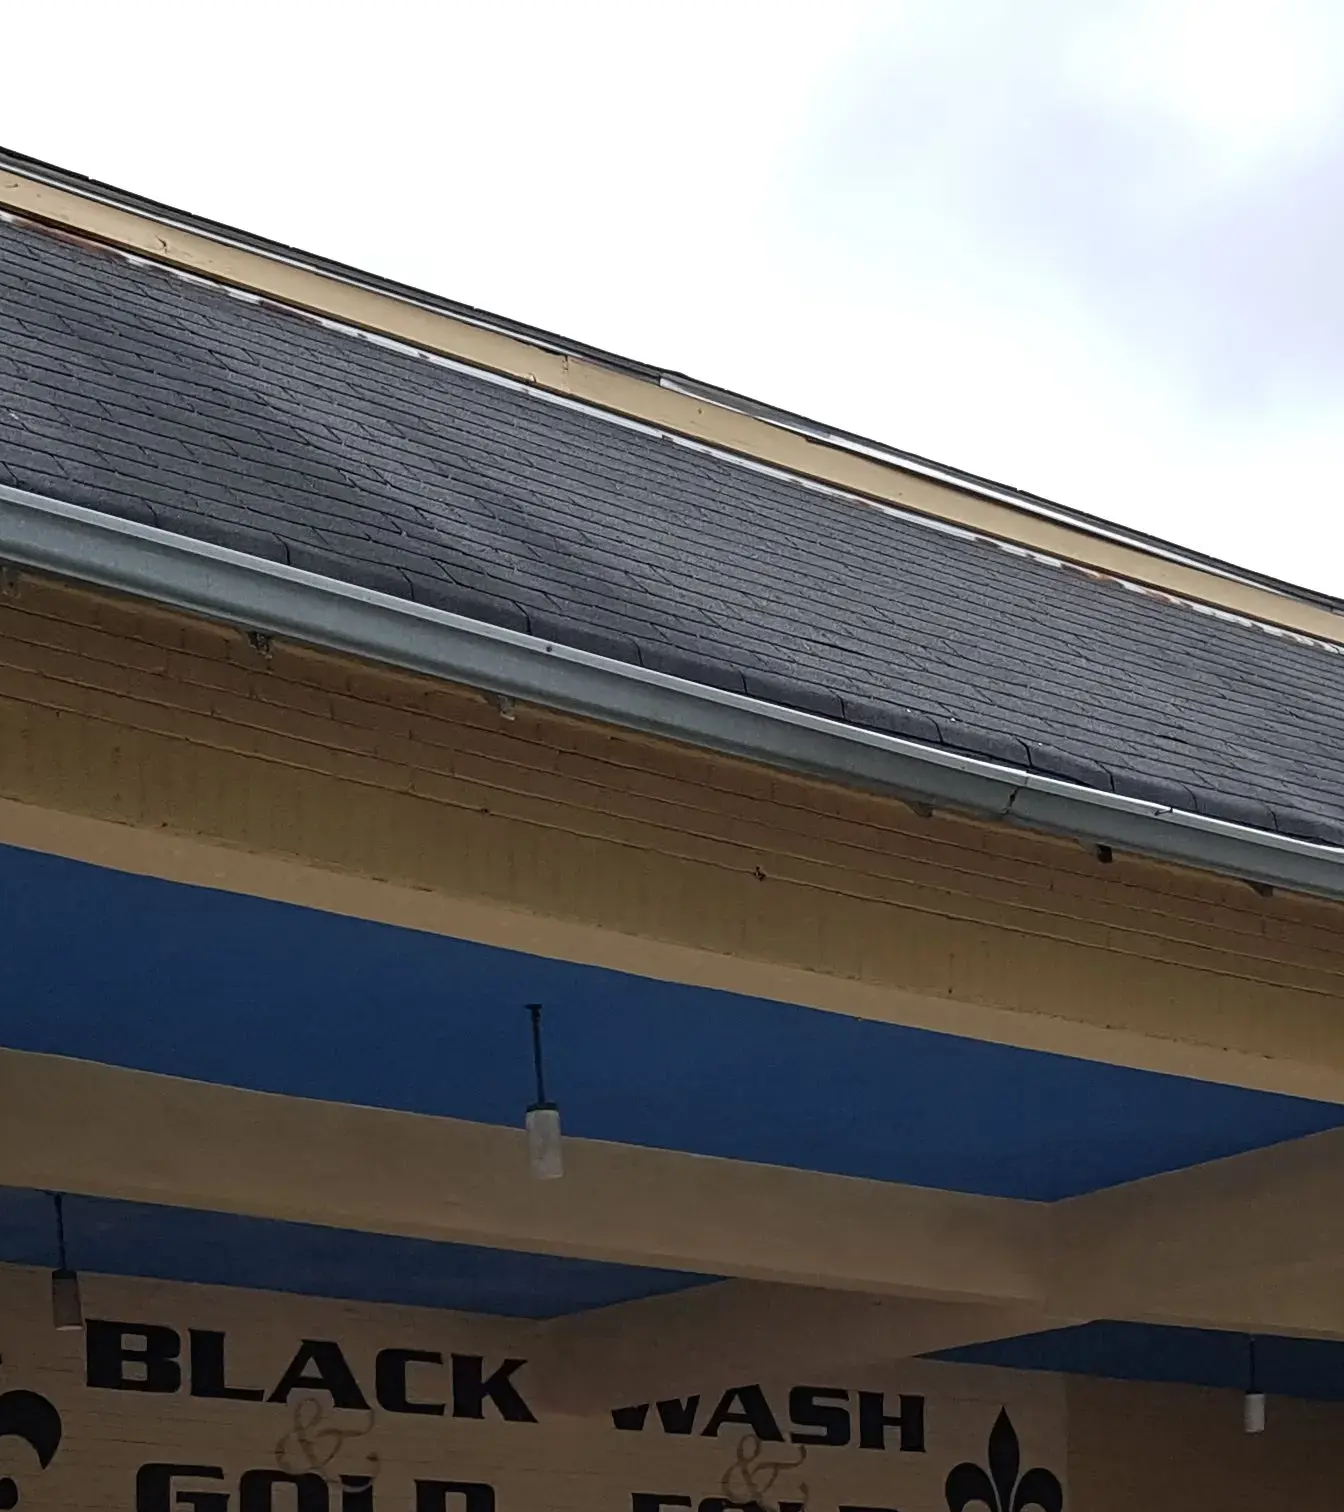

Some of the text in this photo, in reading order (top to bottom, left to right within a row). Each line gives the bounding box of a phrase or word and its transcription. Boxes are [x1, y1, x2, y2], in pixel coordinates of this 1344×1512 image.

[85, 1319, 538, 1423] BLACK
[611, 1384, 926, 1453] WASH
[275, 1397, 382, 1493] &
